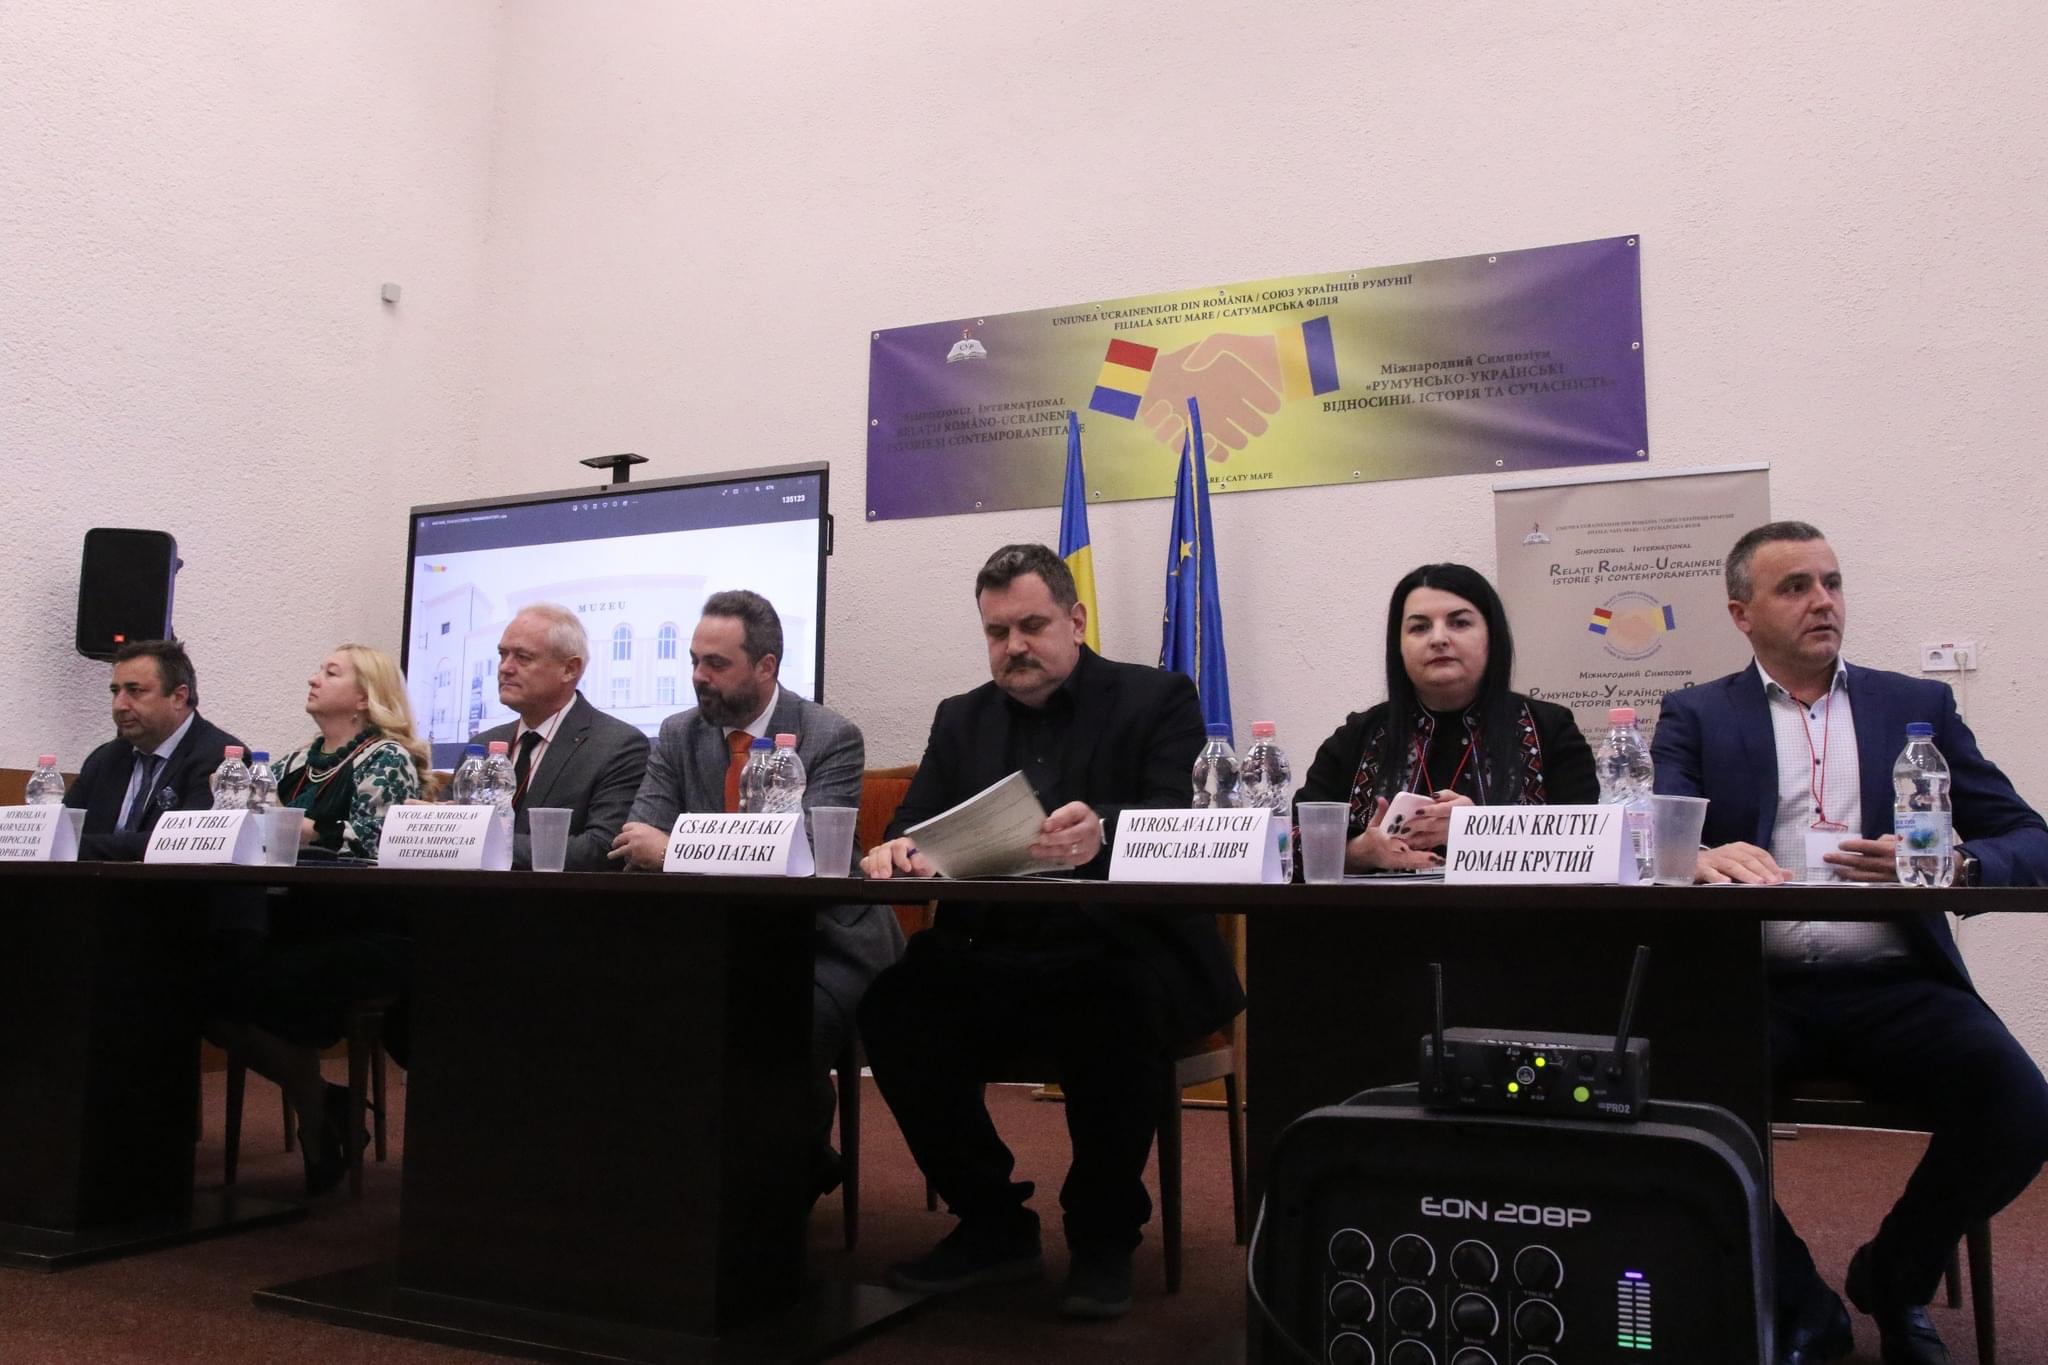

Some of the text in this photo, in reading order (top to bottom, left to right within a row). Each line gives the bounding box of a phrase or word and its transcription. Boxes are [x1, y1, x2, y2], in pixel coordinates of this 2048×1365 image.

[1052, 313, 1098, 327] UNIUNEA
[1101, 304, 1178, 321] UCRAINENILOR
[1181, 301, 1200, 311] DIN
[1203, 294, 1254, 308] ROMÂNIA
[1262, 289, 1295, 301] СОЮЗ
[1297, 281, 1359, 296] УКРАЇНЦІВ
[1363, 274, 1413, 289] РУМУНІЇ
[1114, 318, 1153, 331] FILIALA
[1155, 315, 1182, 326] SATU
[1184, 311, 1215, 323] MARE
[1223, 300, 1304, 318] САТУМАРСЬКА
[1306, 295, 1339, 307] ФІЛІЯ
[1380, 350, 1552, 375] Міжнародний Симпозіум
[1419, 389, 1481, 404] ІСТОРІЯ
[1484, 386, 1504, 398] ТА
[948, 423, 1086, 448] CONTEMPORANEITAE
[1552, 576, 1591, 586] ISTORIE
[1607, 569, 1722, 582] CONTEMPORANEITATE
[578, 601, 626, 612] MUZEU
[1570, 699, 1611, 708] ІСТОРІЯ
[1616, 698, 1630, 707] ТА
[161, 816, 196, 829] IOAN
[196, 815, 230, 829] TIBIL
[395, 811, 479, 820] NICOLAE MIROSLAV
[679, 819, 727, 835] CSABA
[728, 819, 783, 835] PATAKI
[1127, 816, 1204, 832] MYROSLAVA
[1206, 816, 1254, 832] LYVCH
[1463, 814, 1529, 836] ROMAN
[1530, 813, 1600, 836] KRUTYI
[155, 837, 189, 850] ІОАН
[387, 836, 476, 845] МИКОЛА МИРОСЛАВ
[0, 848, 38, 857] ОРНЕЛЮК
[398, 847, 459, 858] ПЕТРЕЦЬКИЙ
[674, 843, 776, 862] ЧОБО ПАТАКІ
[1122, 842, 1250, 858] МИРОСЛАВА ЛИВЧ
[1453, 845, 1595, 872] РОМАН КРУТИЙ
[1420, 1196, 1592, 1228] EON 208P
